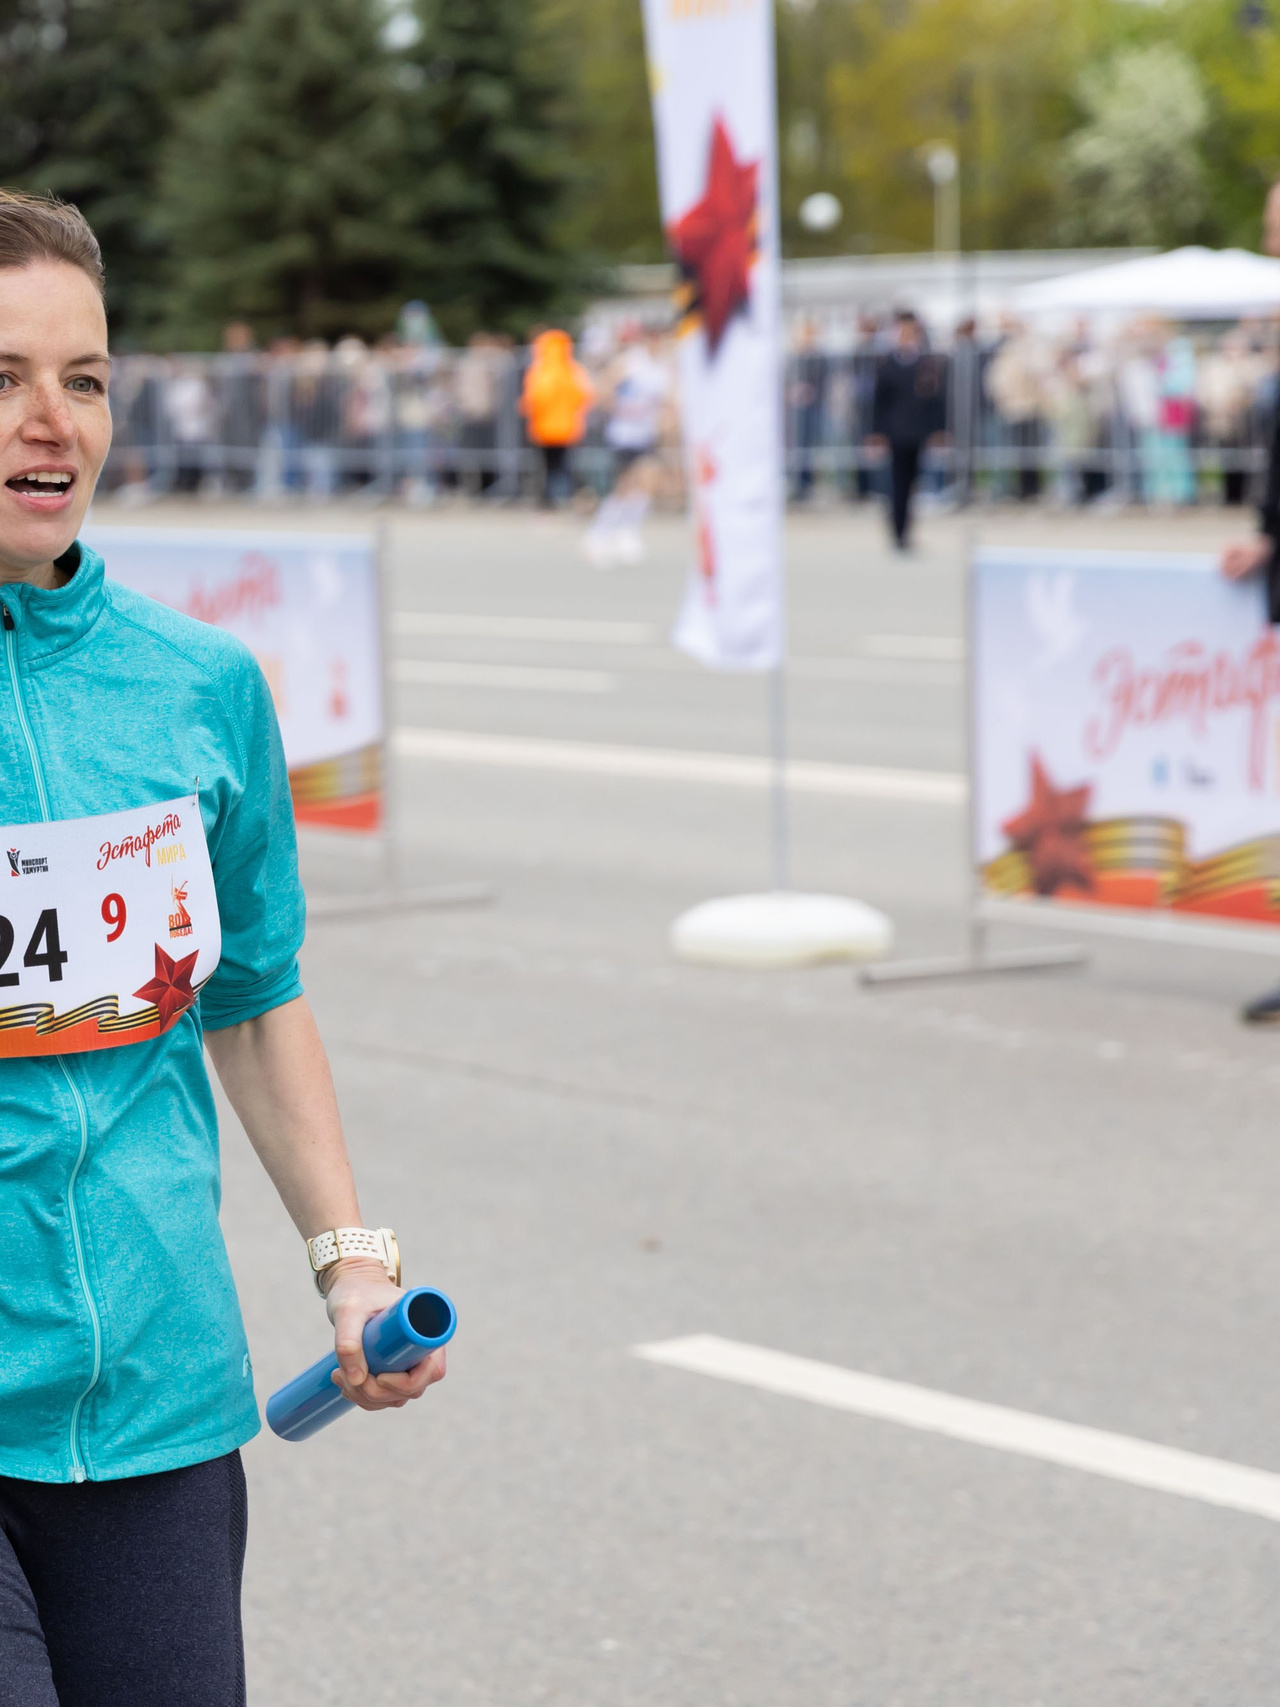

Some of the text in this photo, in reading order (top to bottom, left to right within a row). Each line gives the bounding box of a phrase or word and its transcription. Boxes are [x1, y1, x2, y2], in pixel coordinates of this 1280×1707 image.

[97, 813, 181, 871] Эстафета
[156, 843, 187, 866] МИРА
[21, 857, 48, 867] МИНСПОРТ
[101, 892, 127, 943] 9
